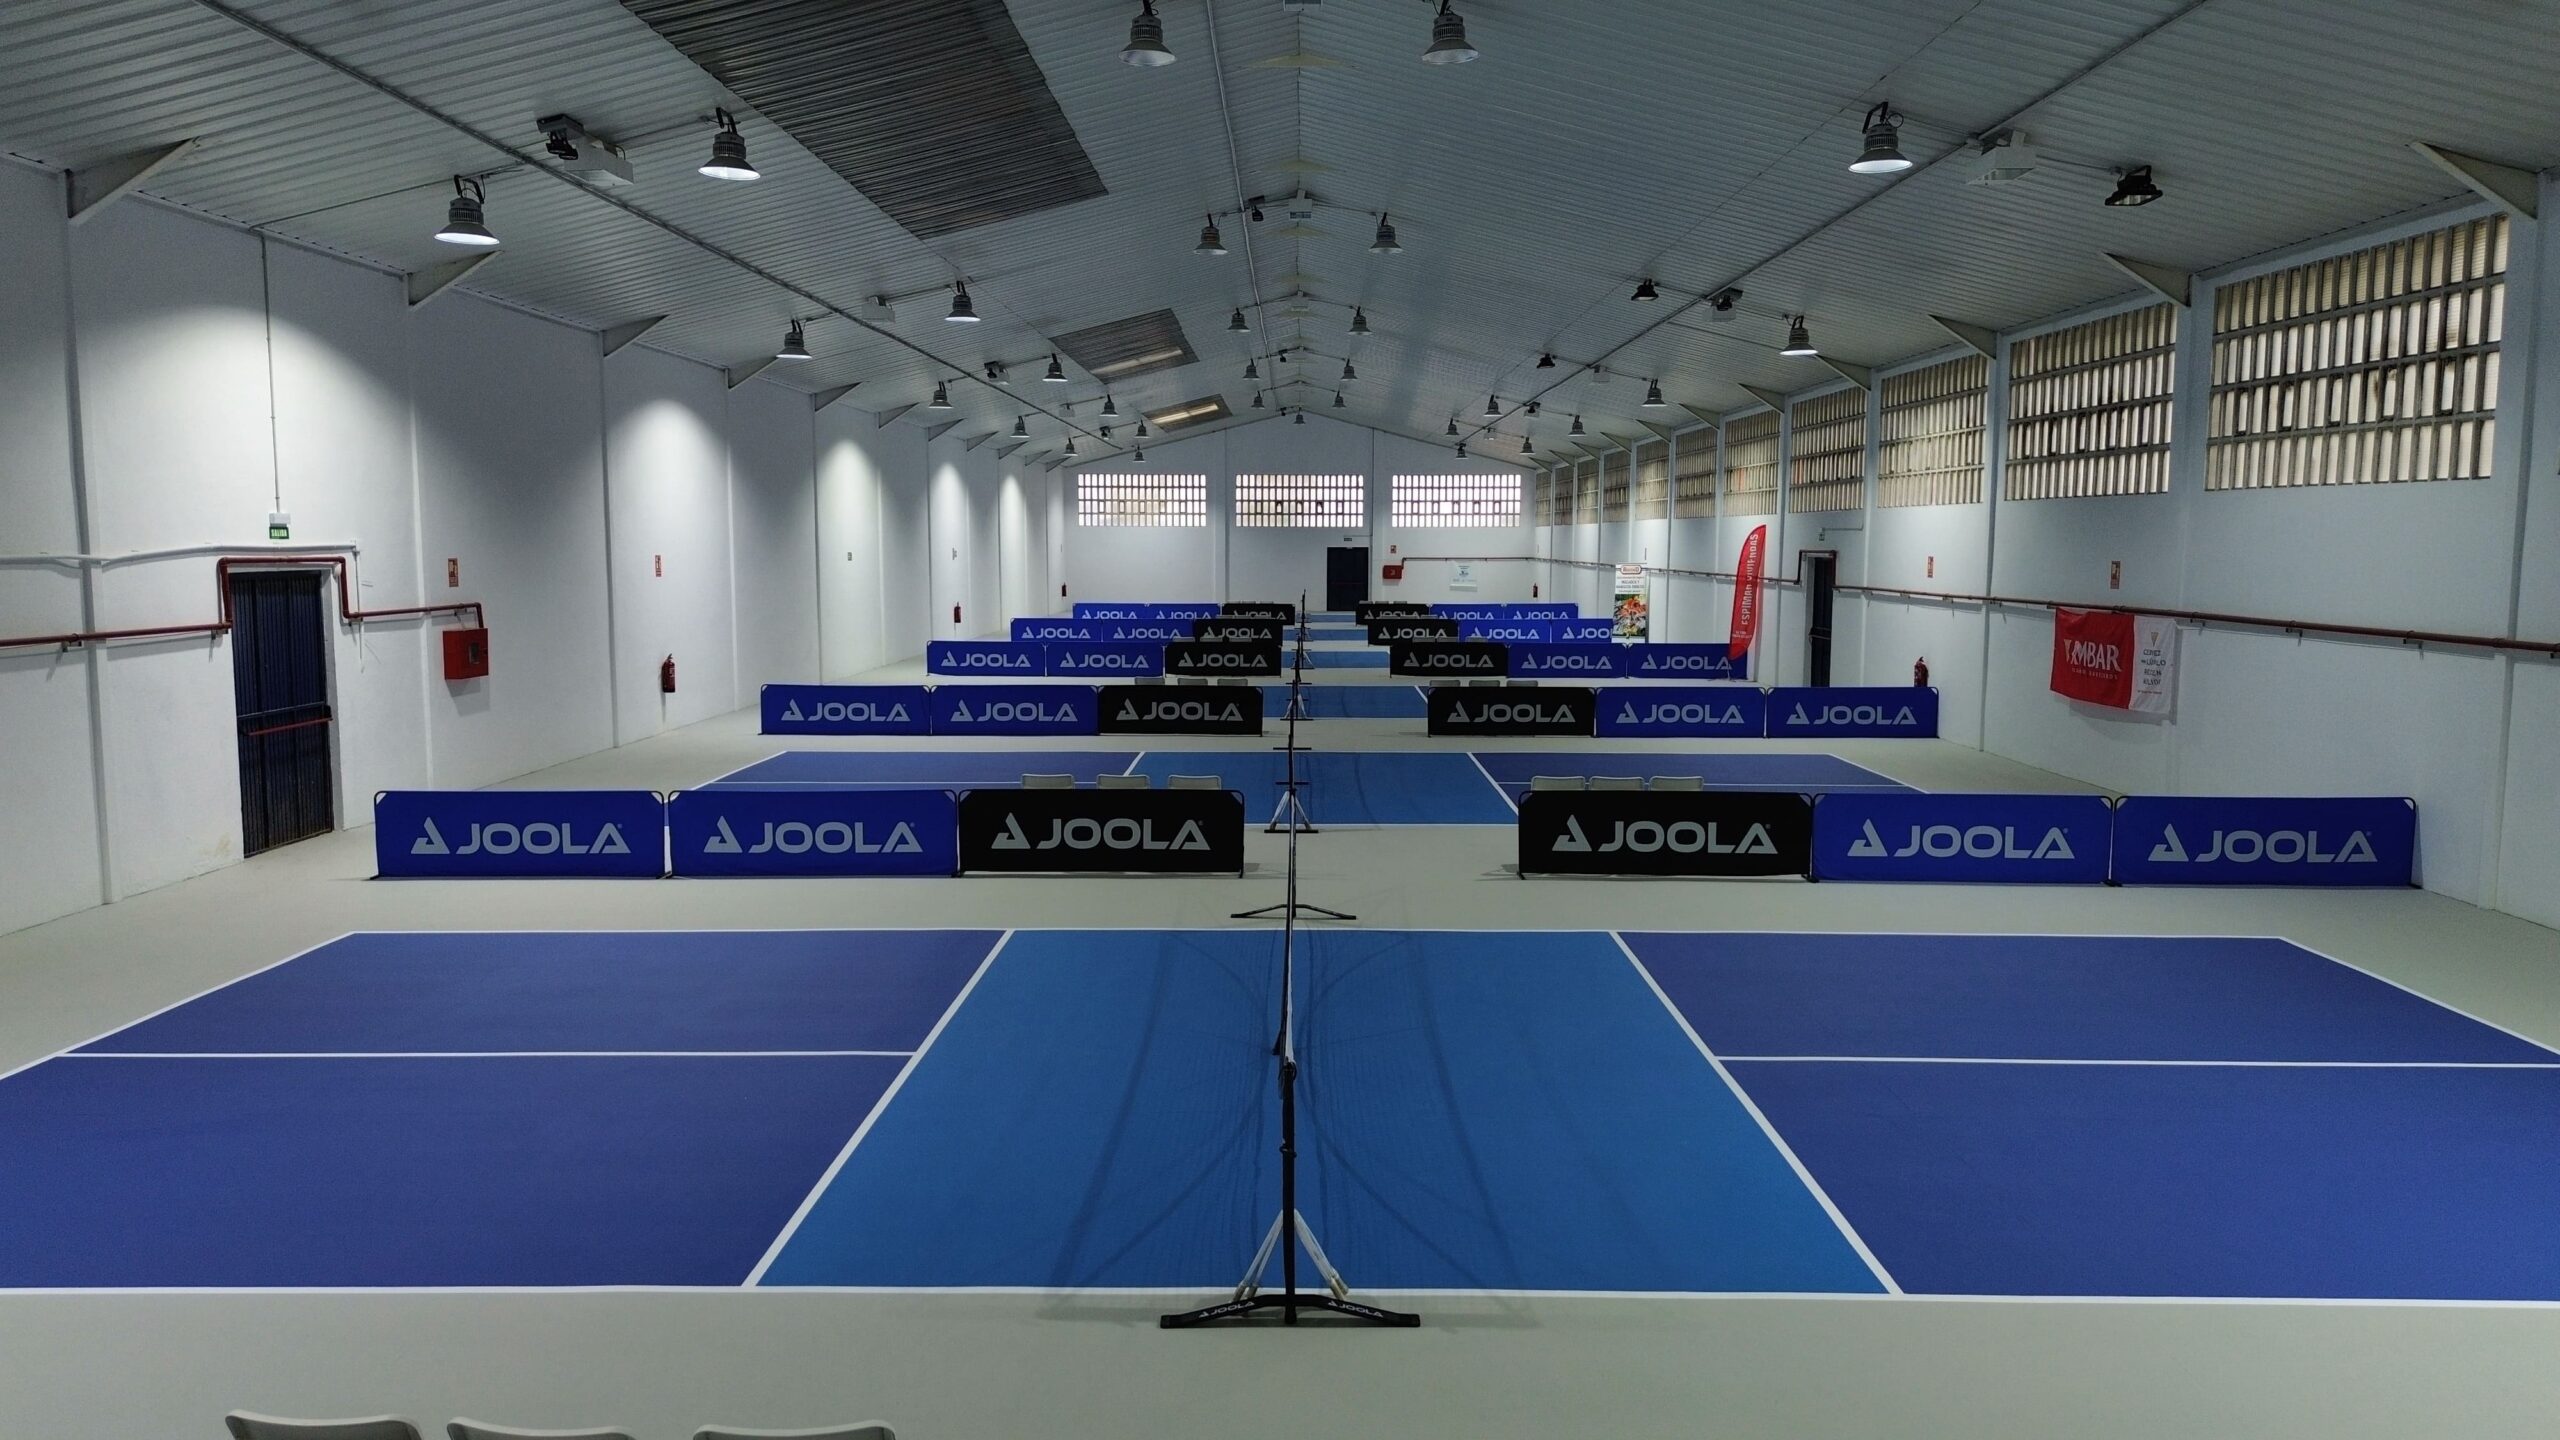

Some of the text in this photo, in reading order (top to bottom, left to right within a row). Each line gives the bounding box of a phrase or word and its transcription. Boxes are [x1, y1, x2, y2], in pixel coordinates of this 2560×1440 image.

[1095, 611, 1138, 619] JOOLA
[1036, 628, 1091, 638] JOOLA
[1127, 628, 1182, 639] JOOLA
[1217, 628, 1272, 638] JOOLA
[1393, 628, 1447, 638] JOOLA
[1487, 629, 1539, 639] JOOLA
[960, 654, 1031, 667] JOOLA
[1078, 654, 1149, 668] JOOLA
[1197, 654, 1268, 667] JOOLA
[1422, 654, 1494, 667] JOOLA
[1540, 655, 1612, 669] JOOLA
[1660, 655, 1732, 670] JOOLA
[808, 703, 911, 722] JOOLA
[977, 703, 1078, 722] JOOLA
[1143, 702, 1243, 722] JOOLA
[1472, 704, 1576, 722] JOOLA
[1642, 704, 1744, 723] JOOLA
[1813, 705, 1917, 725] JOOLA
[456, 822, 631, 855] JOOLA
[749, 821, 923, 854] JOOLA
[1036, 818, 1211, 850] JOOLA
[1597, 821, 1778, 855] JOOLA
[1893, 825, 2075, 860] JOOLA
[2195, 831, 2378, 863] JOOLA
[1210, 1301, 1255, 1315] JOOLA
[1339, 1304, 1384, 1317] JOOLA
